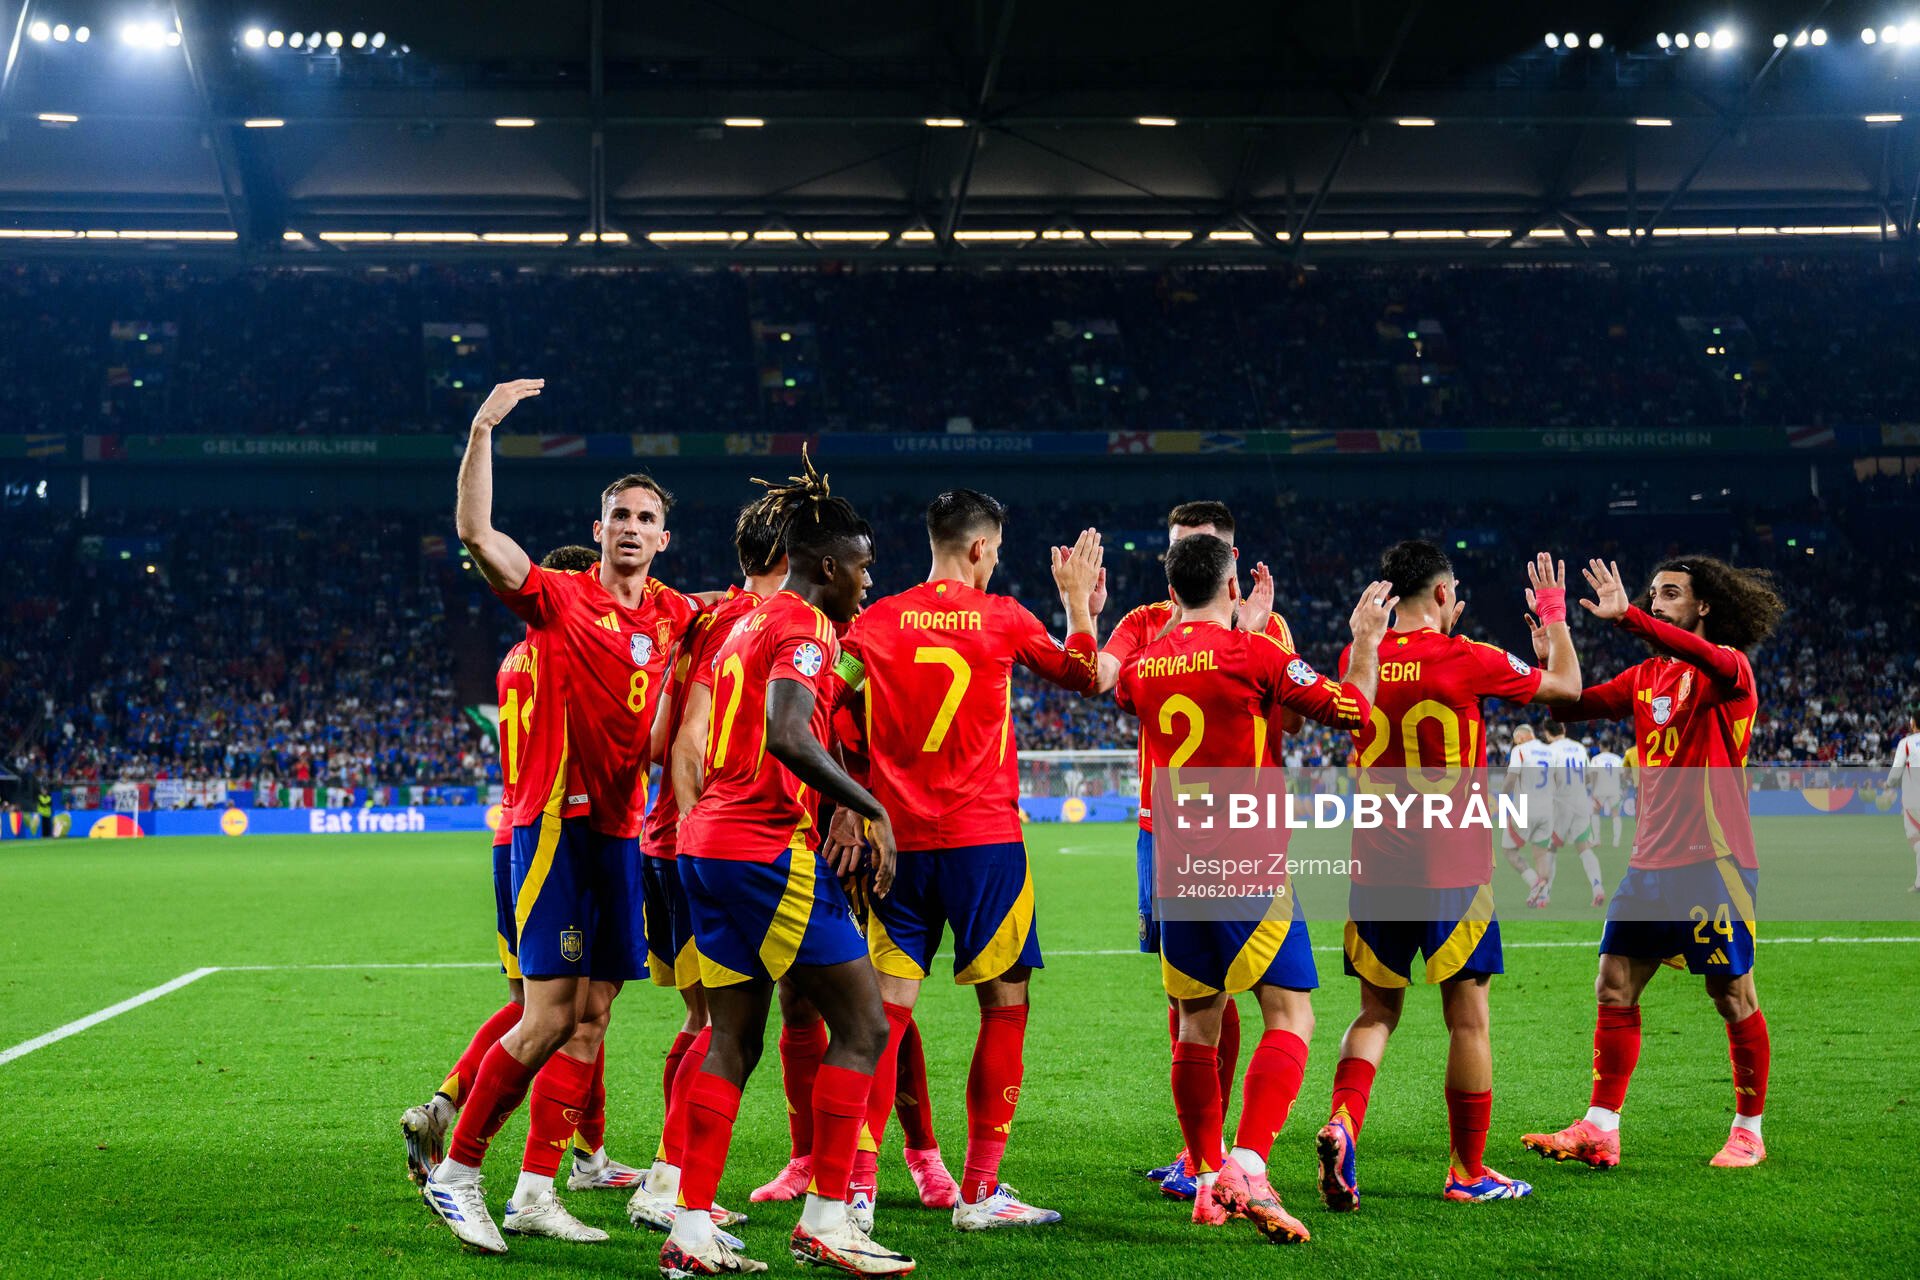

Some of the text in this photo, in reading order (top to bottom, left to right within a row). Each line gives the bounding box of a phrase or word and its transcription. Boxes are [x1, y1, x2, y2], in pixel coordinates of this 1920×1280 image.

[893, 437, 1033, 451] UEFA EURO 2024
[1541, 431, 1712, 447] GELSENKIRCHEN
[900, 610, 982, 630] MORATA
[1137, 649, 1219, 679] CARVAJAL
[1378, 661, 1421, 682] EDRI
[627, 669, 649, 713] 8
[914, 646, 972, 752] 7
[499, 688, 535, 784] 1
[1158, 693, 1210, 801] 2
[1352, 699, 1462, 799] 20
[1536, 760, 1549, 789] 3
[1565, 756, 1584, 785] 14
[309, 807, 425, 833] Eat fresh
[1689, 903, 1734, 944] 24
